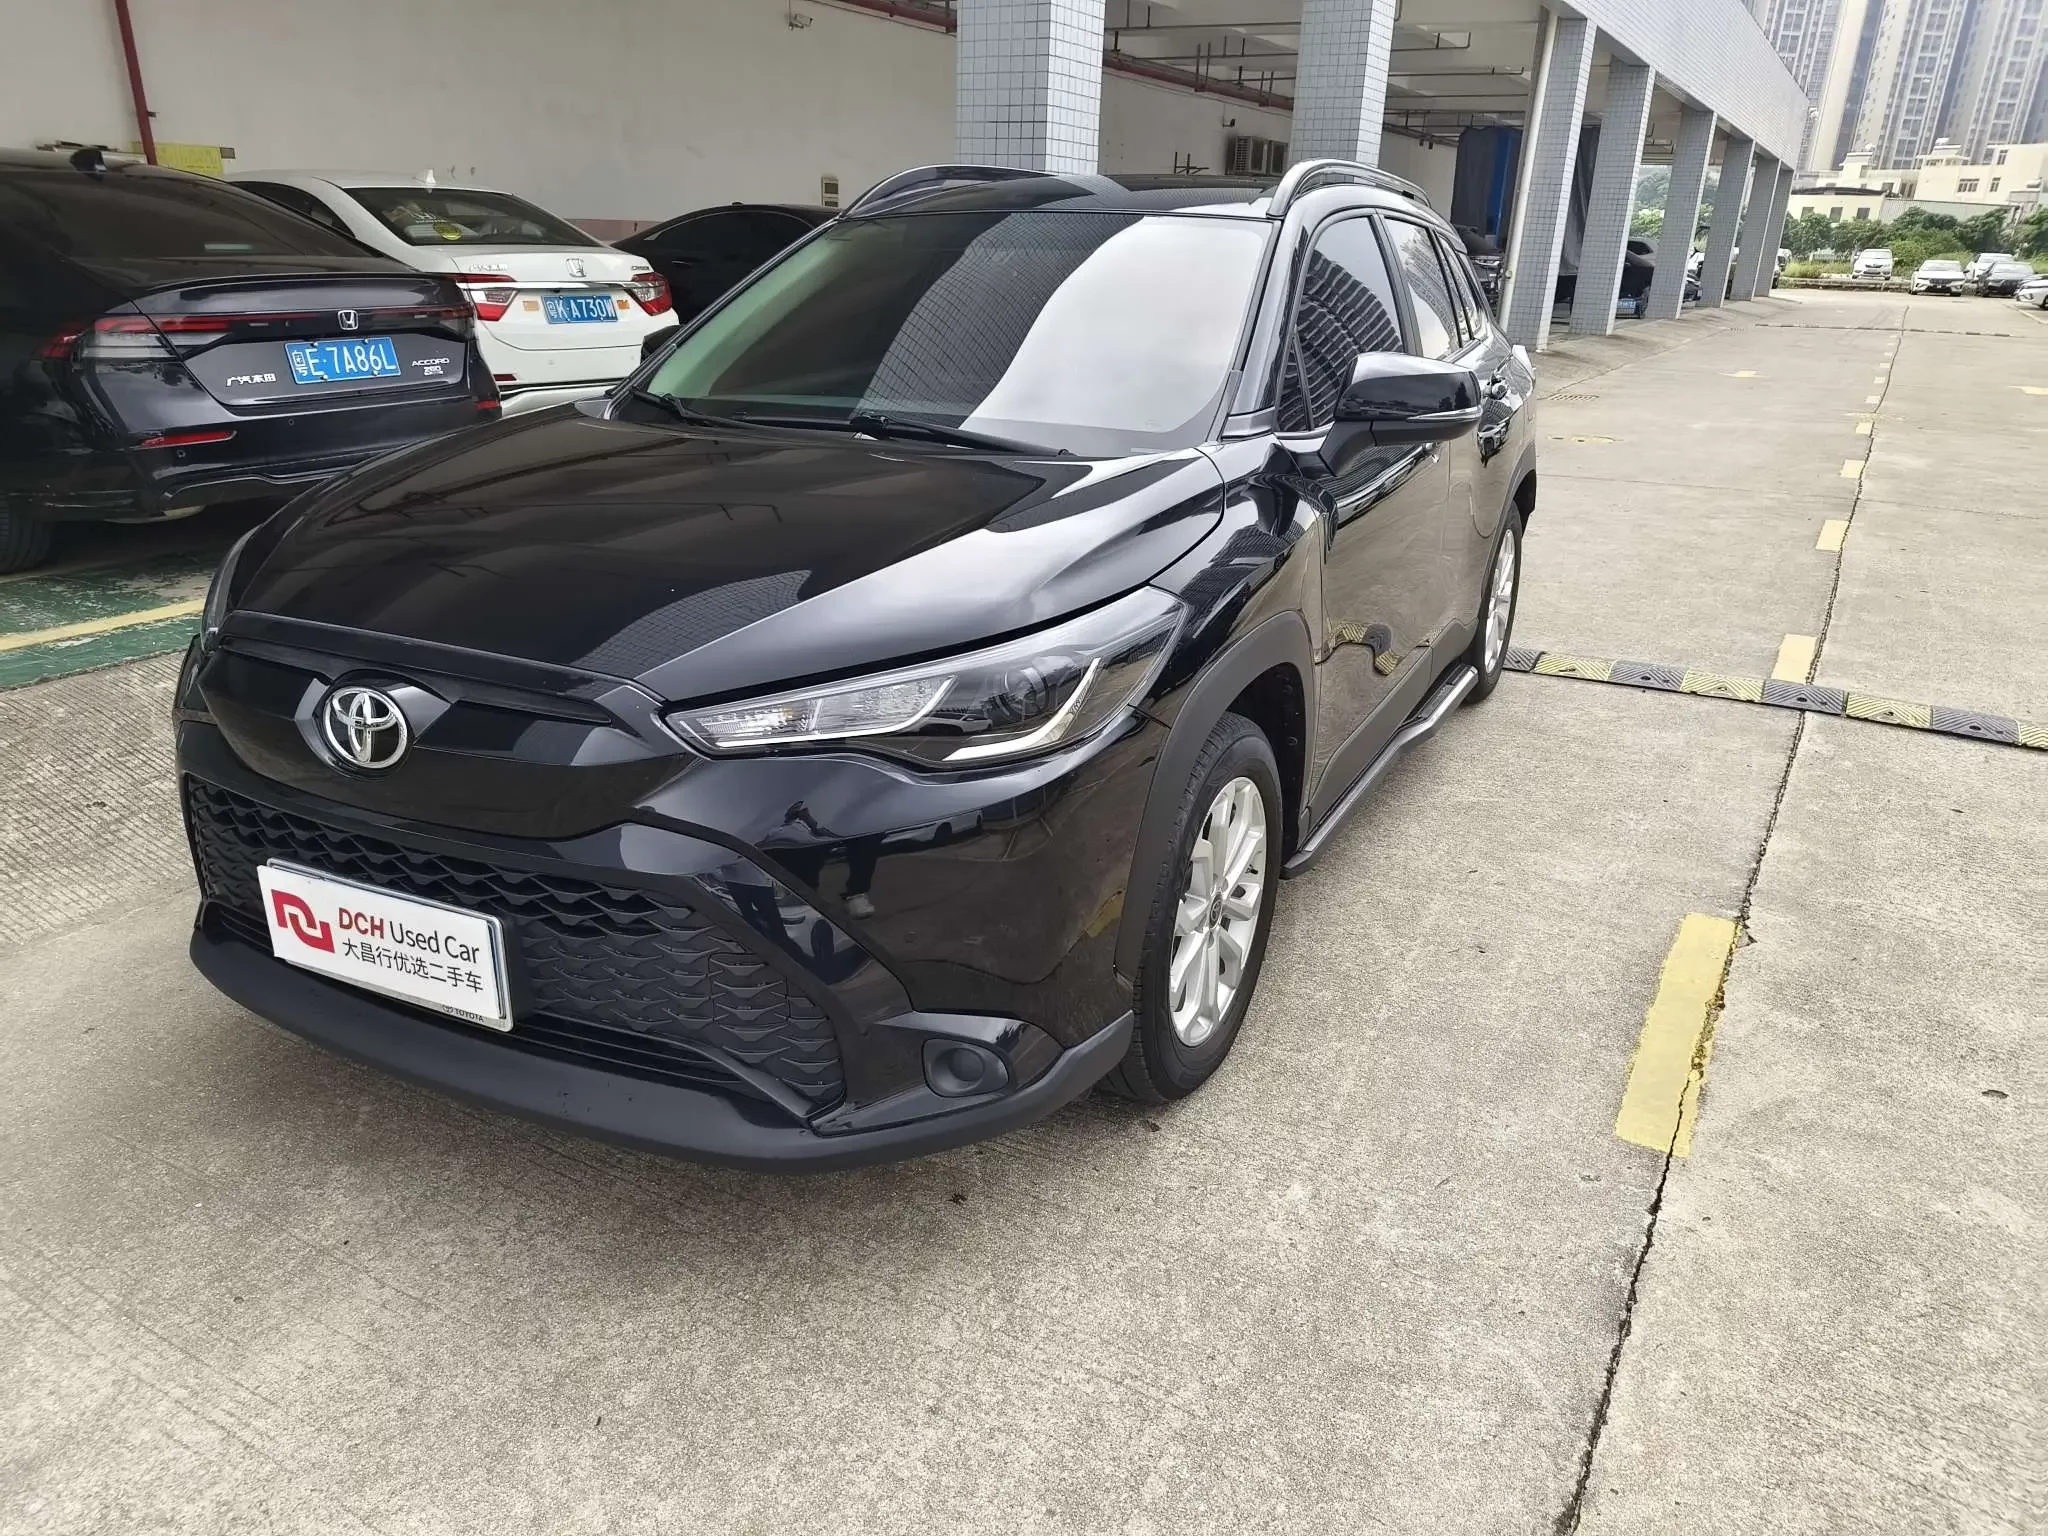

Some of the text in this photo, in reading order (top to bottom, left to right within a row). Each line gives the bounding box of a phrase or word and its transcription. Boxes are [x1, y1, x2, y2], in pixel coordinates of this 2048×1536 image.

[411, 357, 450, 367] ACCORD
[338, 907, 480, 964] DCH Used Car
[342, 938, 483, 993] 大昌行优选二手车
[454, 1007, 485, 1023] TOYOTA
